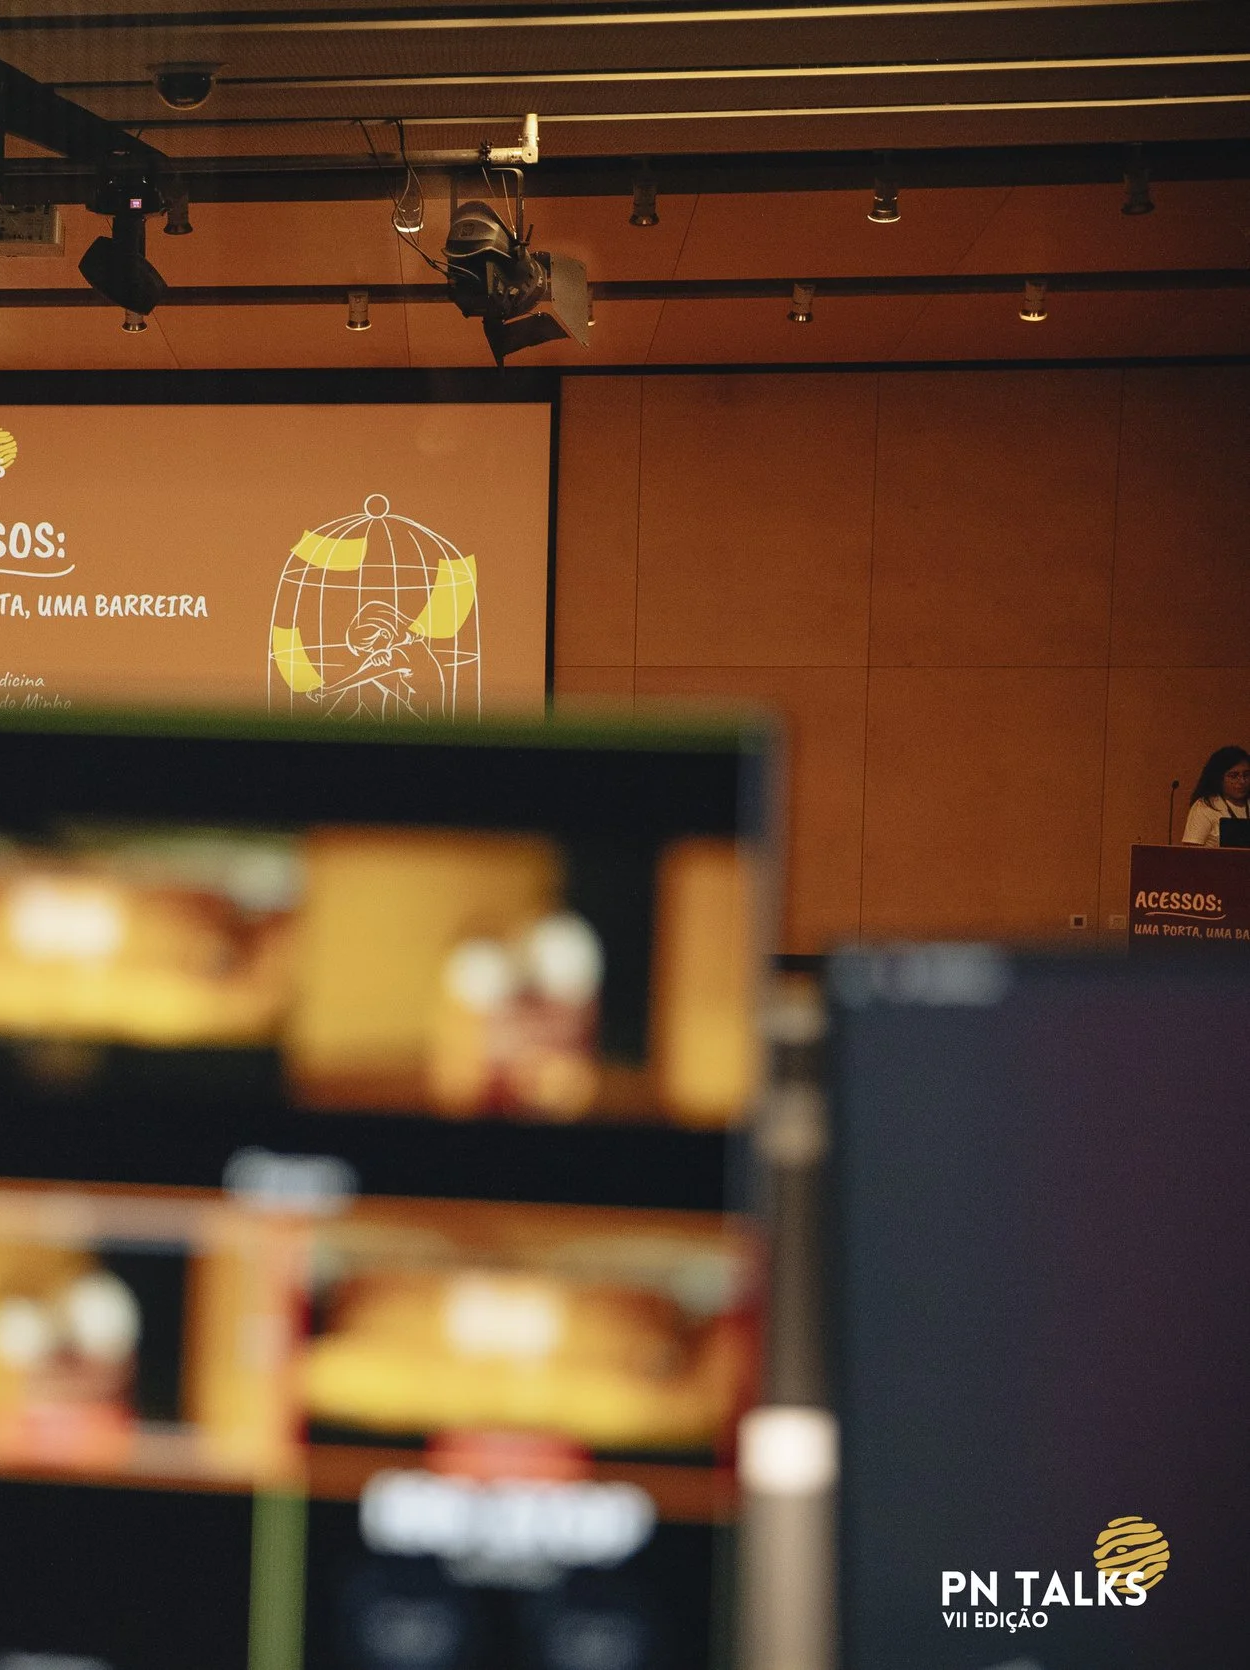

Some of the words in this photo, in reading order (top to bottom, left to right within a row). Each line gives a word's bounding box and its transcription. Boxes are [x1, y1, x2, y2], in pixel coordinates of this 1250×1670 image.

[37, 594, 88, 618] UMA
[95, 594, 208, 618] BARREIRA
[1135, 891, 1222, 912] ACESSOS:
[1134, 923, 1159, 935] UMA
[1162, 924, 1203, 938] PORTA,
[1206, 927, 1232, 938] UMA
